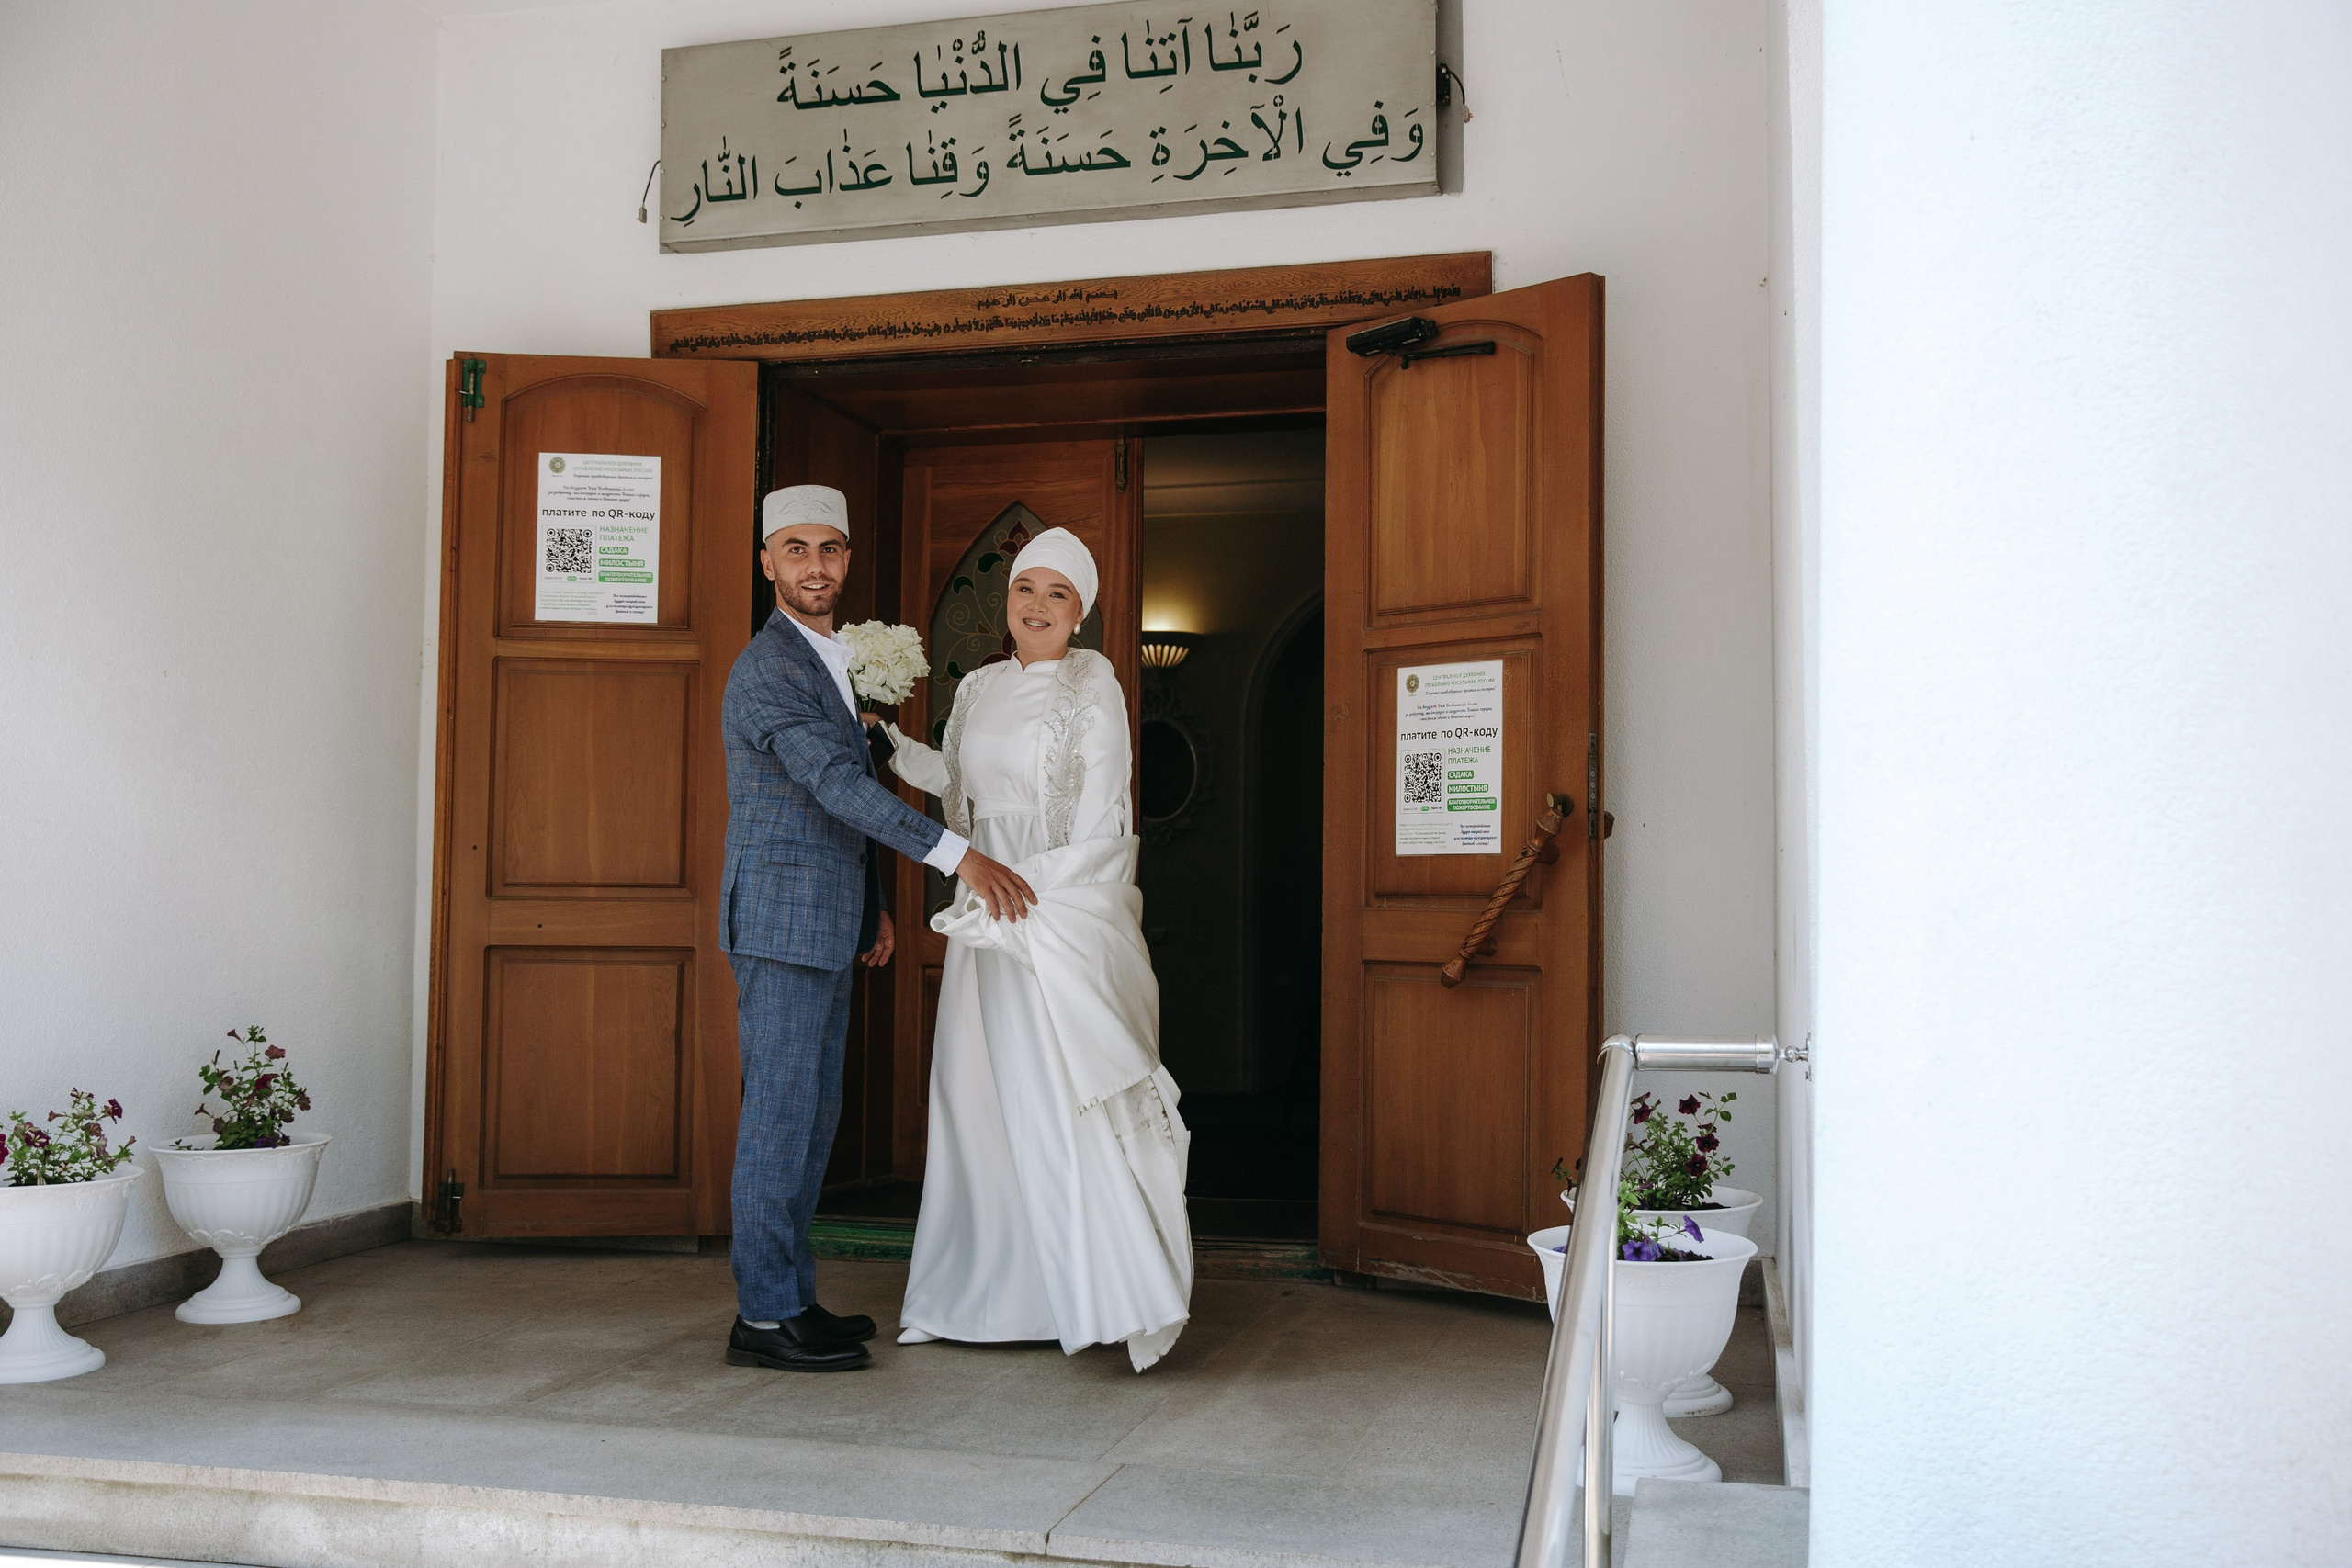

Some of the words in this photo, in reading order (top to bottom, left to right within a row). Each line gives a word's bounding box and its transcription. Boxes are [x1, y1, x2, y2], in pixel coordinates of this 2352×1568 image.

[542, 509, 587, 517] платите
[591, 509, 605, 517] по
[608, 509, 655, 521] QR-коду
[600, 525, 649, 534] НАЗНАЧЕНИЕ
[1400, 731, 1437, 740] платите
[1441, 730, 1452, 739] по
[1454, 728, 1498, 739] QR-коду
[1448, 746, 1491, 754] НАЗНАЧЕНИЕ
[1449, 784, 1487, 793] МИЛОСТЫНЯ
